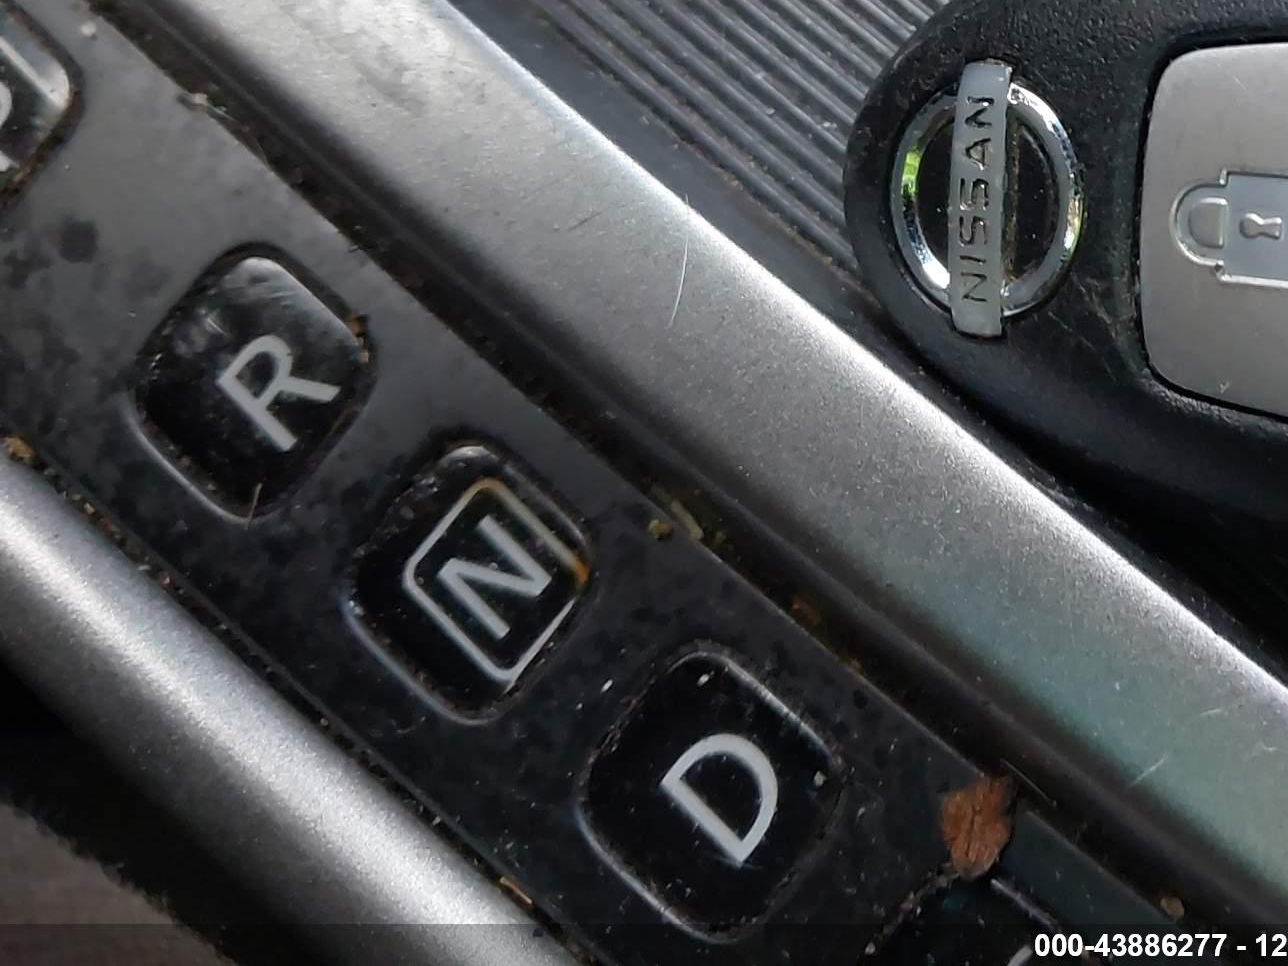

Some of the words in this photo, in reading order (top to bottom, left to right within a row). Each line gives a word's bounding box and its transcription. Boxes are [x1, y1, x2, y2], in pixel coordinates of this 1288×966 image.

[959, 95, 995, 303] NISSAN
[216, 334, 340, 452] R
[438, 514, 552, 638] N
[660, 733, 779, 868] D
